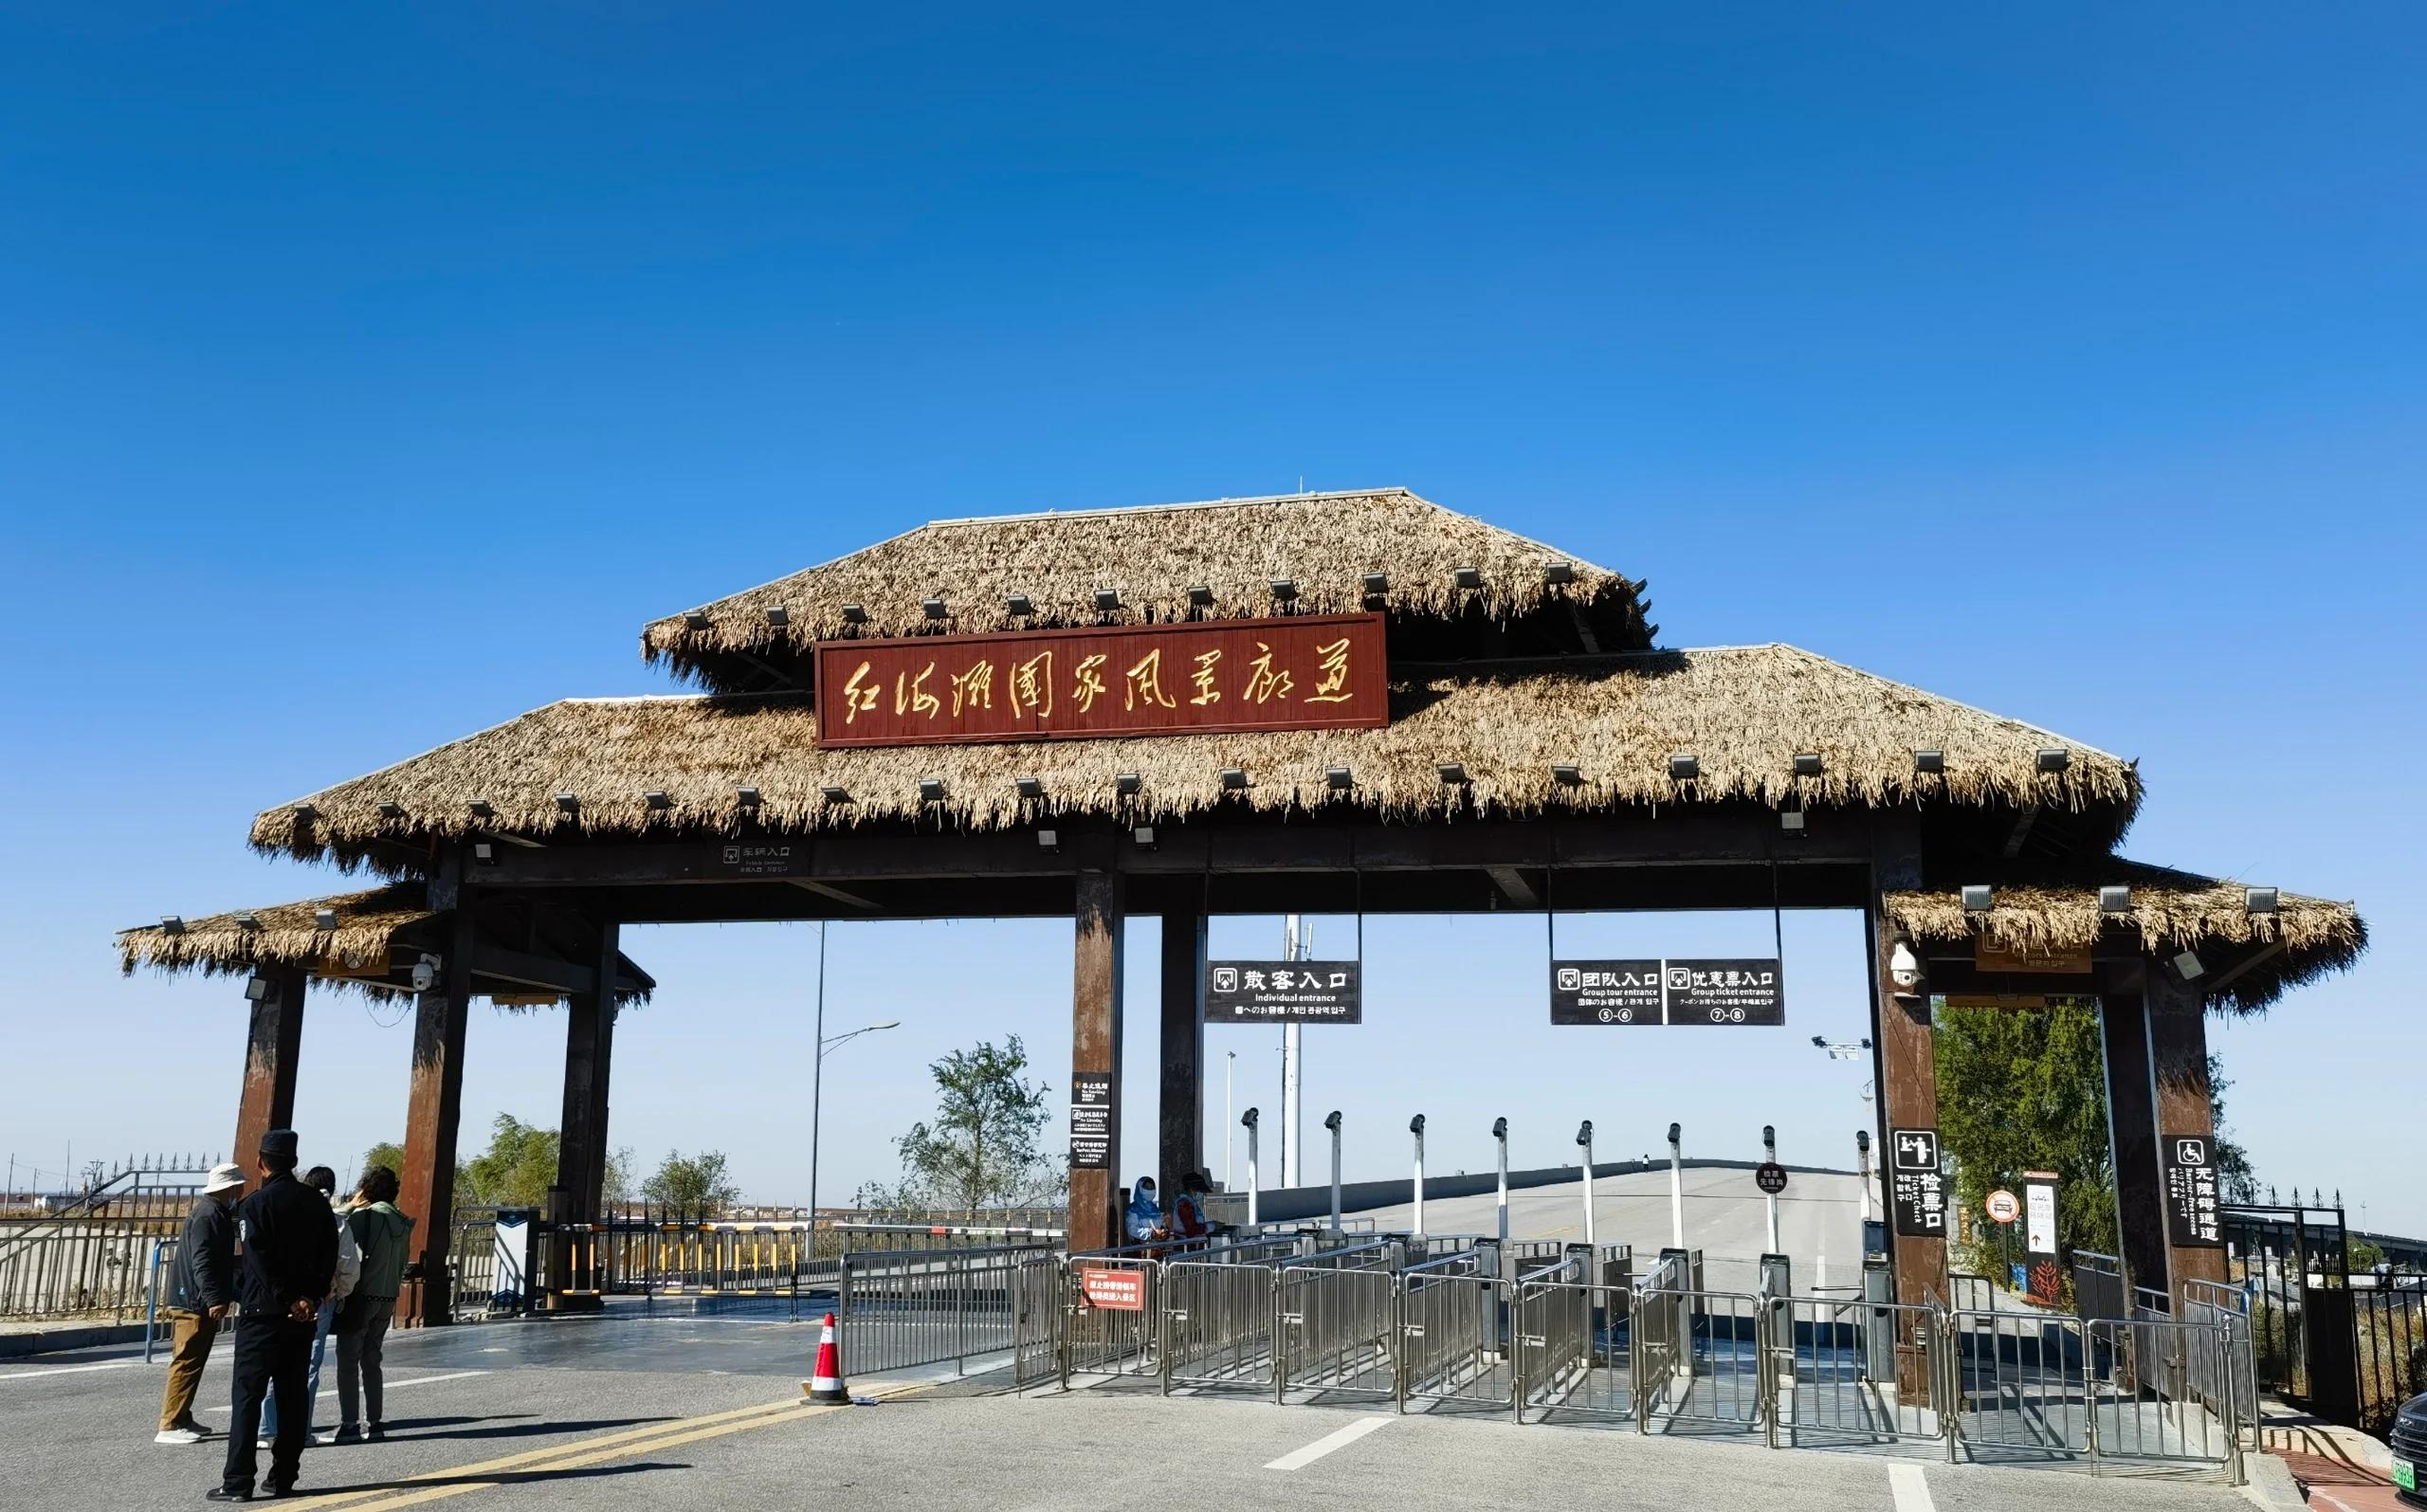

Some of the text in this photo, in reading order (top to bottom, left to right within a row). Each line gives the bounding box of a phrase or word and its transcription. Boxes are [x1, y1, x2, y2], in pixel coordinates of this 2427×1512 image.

[1244, 970, 1347, 991] 散客入口
[1581, 973, 1658, 987] 团队入口
[1691, 971, 1773, 987] 优惠票入口
[1255, 993, 1298, 1002] Individual
[1582, 989, 1606, 997] Group
[1691, 988, 1715, 996] Group
[1920, 1173, 1943, 1228] 检票口
[2196, 1168, 2218, 1241] 无障碍通道
